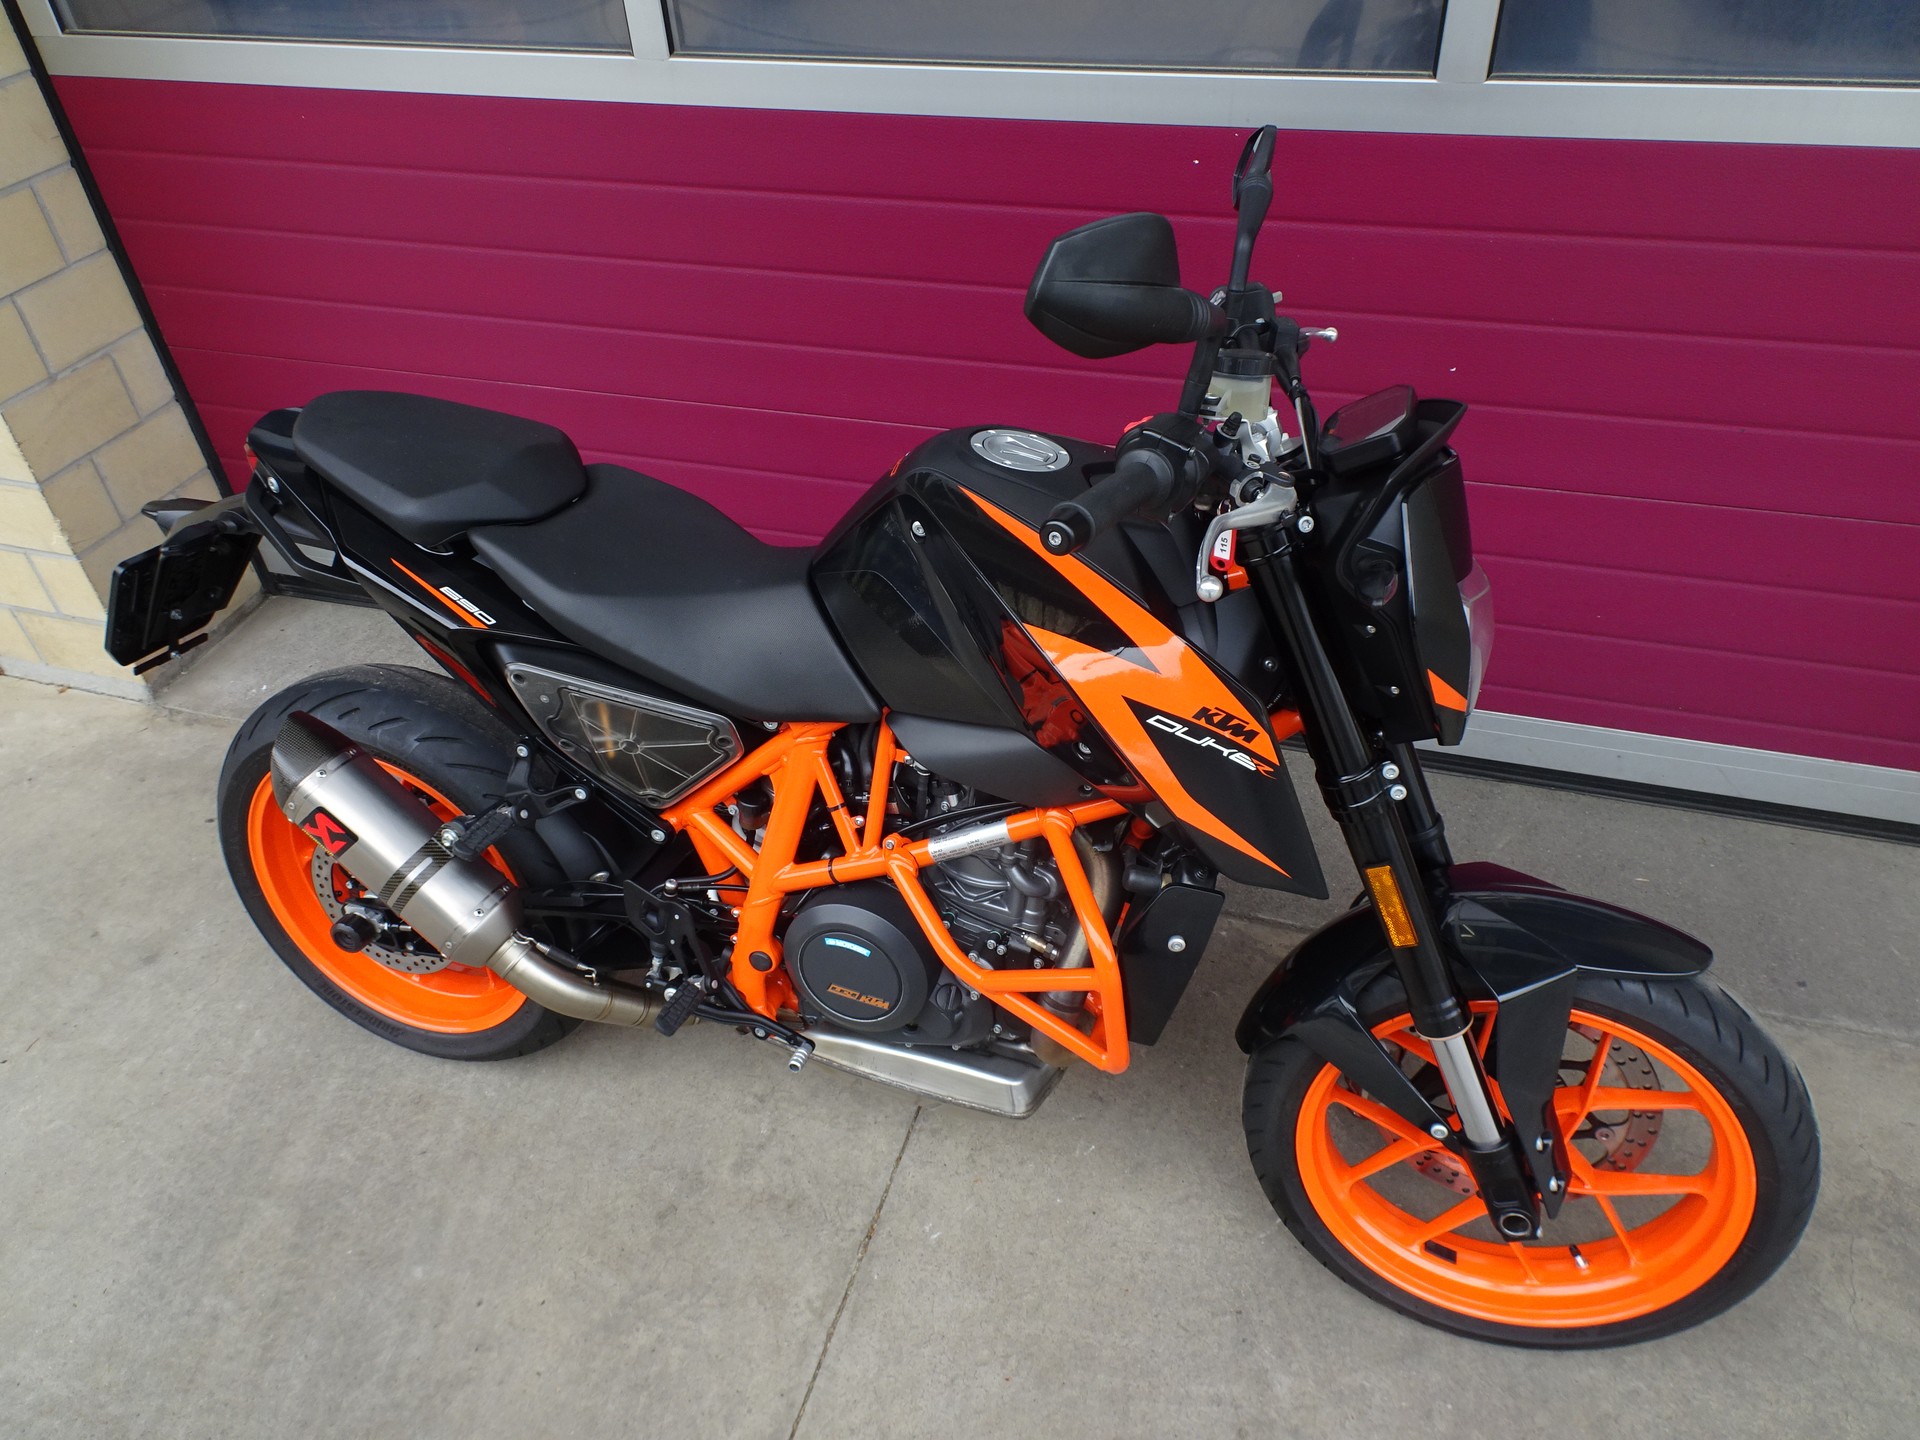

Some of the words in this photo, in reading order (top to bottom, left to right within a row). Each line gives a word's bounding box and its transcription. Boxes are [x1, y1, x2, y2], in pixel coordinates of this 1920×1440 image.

[1219, 537, 1228, 553] 115
[439, 586, 497, 625] 690
[1191, 706, 1261, 744] KTM
